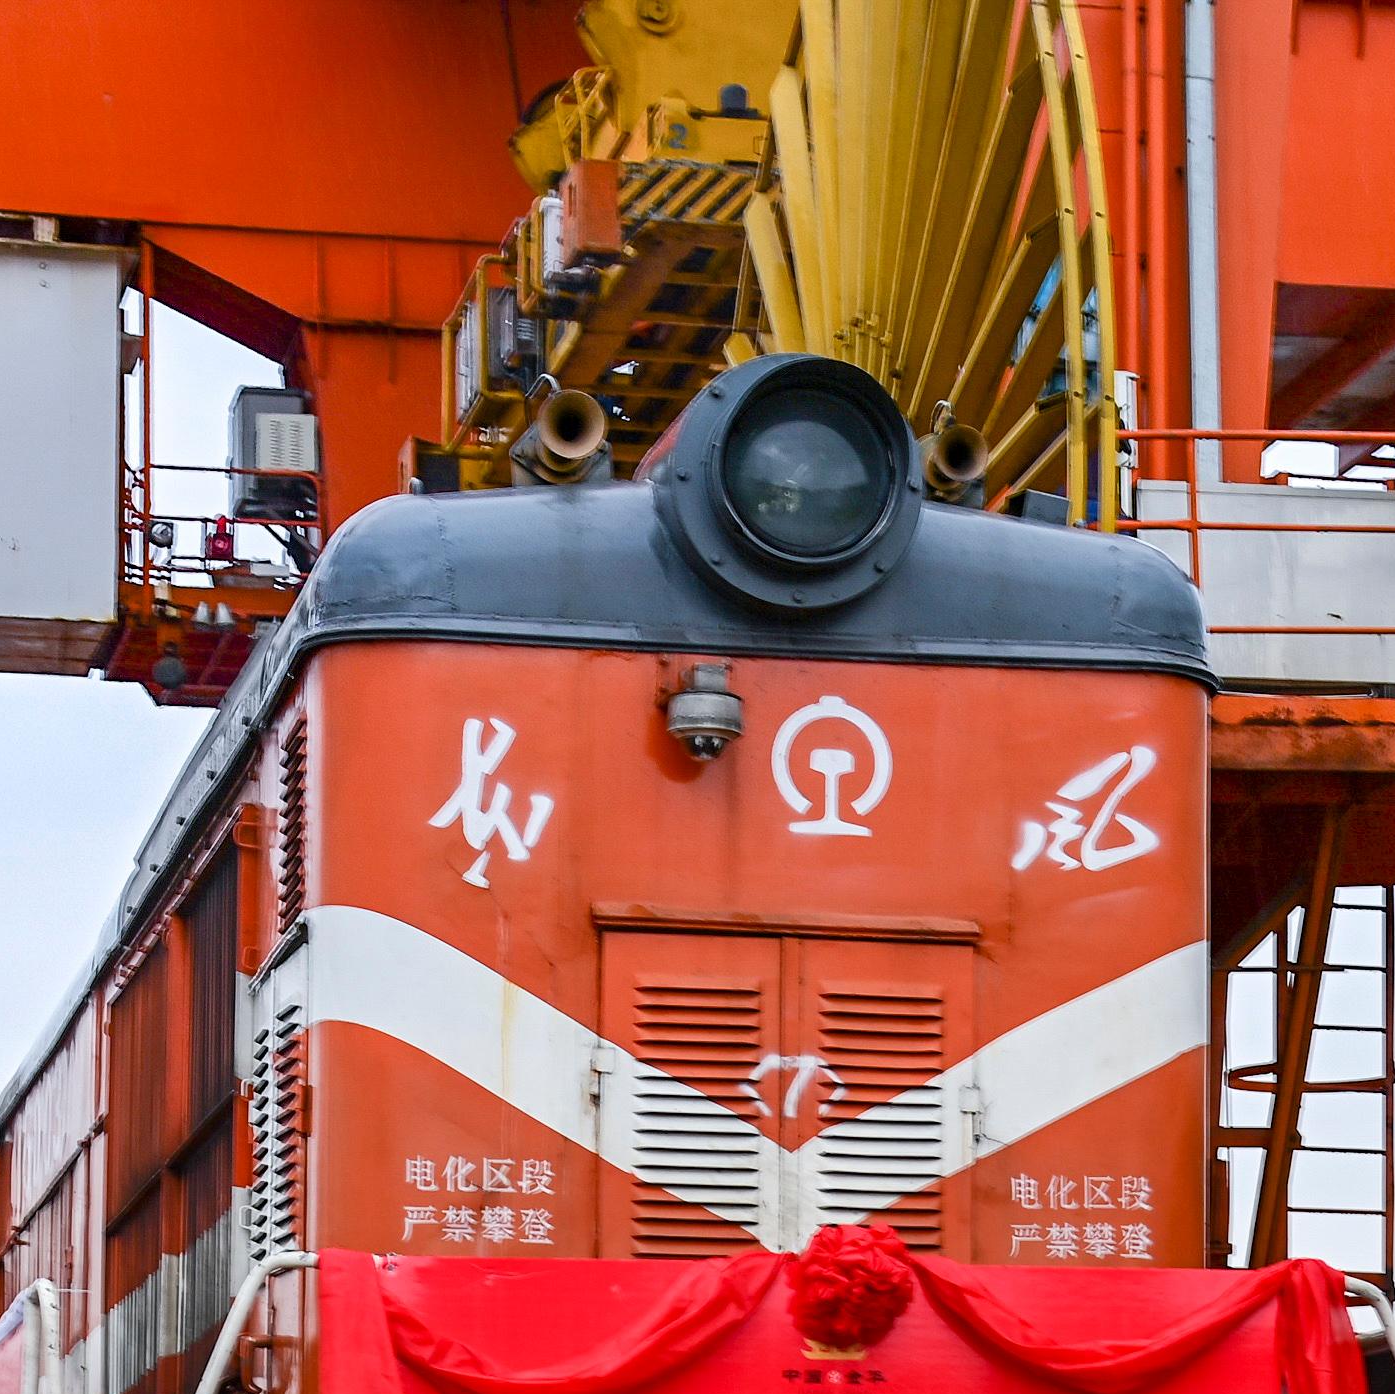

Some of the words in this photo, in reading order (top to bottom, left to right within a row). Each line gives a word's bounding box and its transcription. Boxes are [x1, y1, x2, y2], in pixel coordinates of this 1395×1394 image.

[405, 1155, 556, 1195] 电化区段
[1010, 1173, 1154, 1211] 电化区段
[401, 1205, 555, 1245] 严禁攀登
[1009, 1222, 1154, 1260] 严禁攀登
